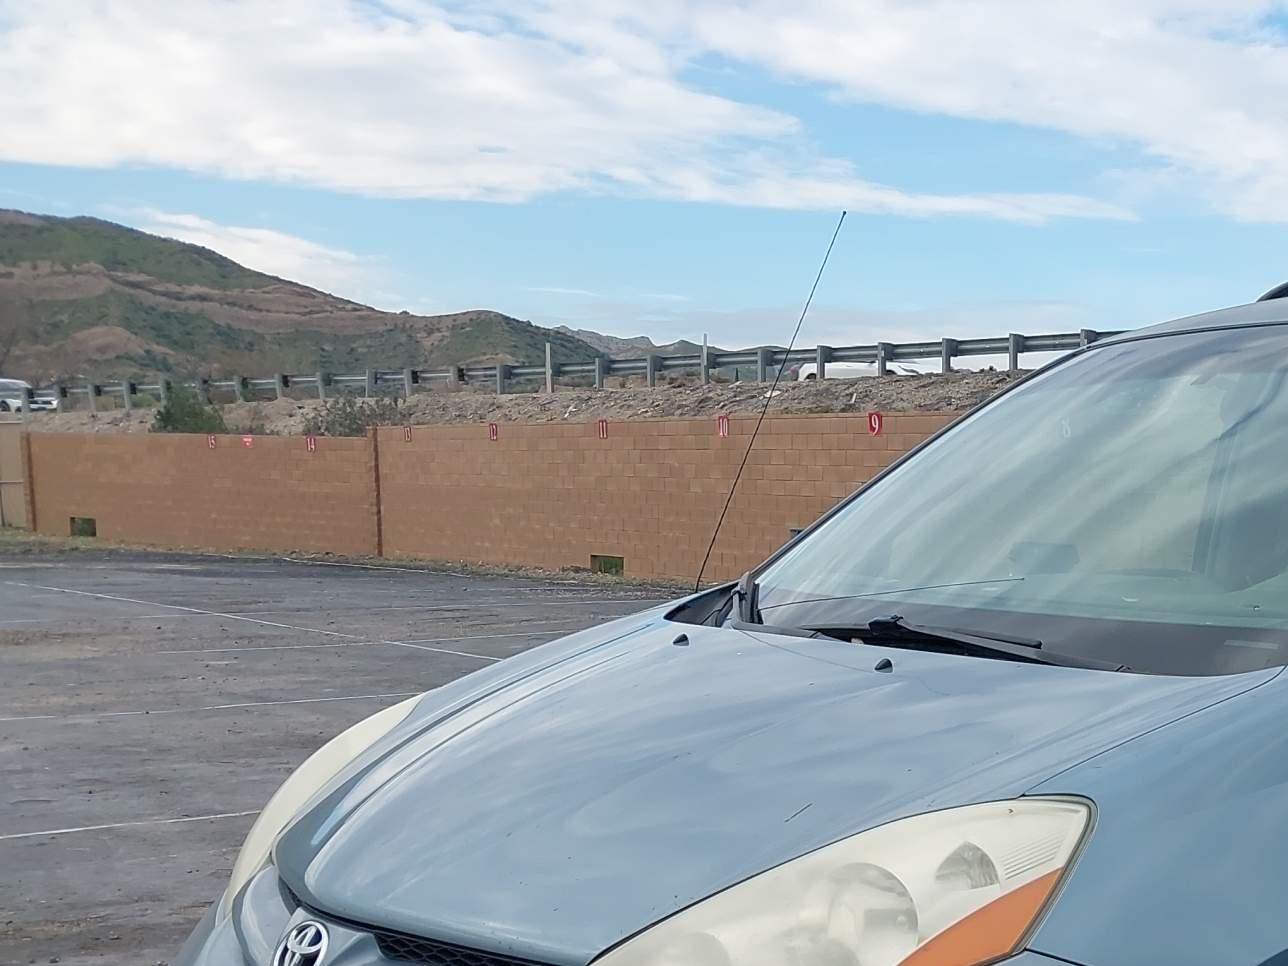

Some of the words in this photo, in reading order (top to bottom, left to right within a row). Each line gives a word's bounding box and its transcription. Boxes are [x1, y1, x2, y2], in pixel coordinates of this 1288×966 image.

[599, 421, 607, 438] 11
[719, 418, 728, 437] 10
[871, 414, 879, 436] 9
